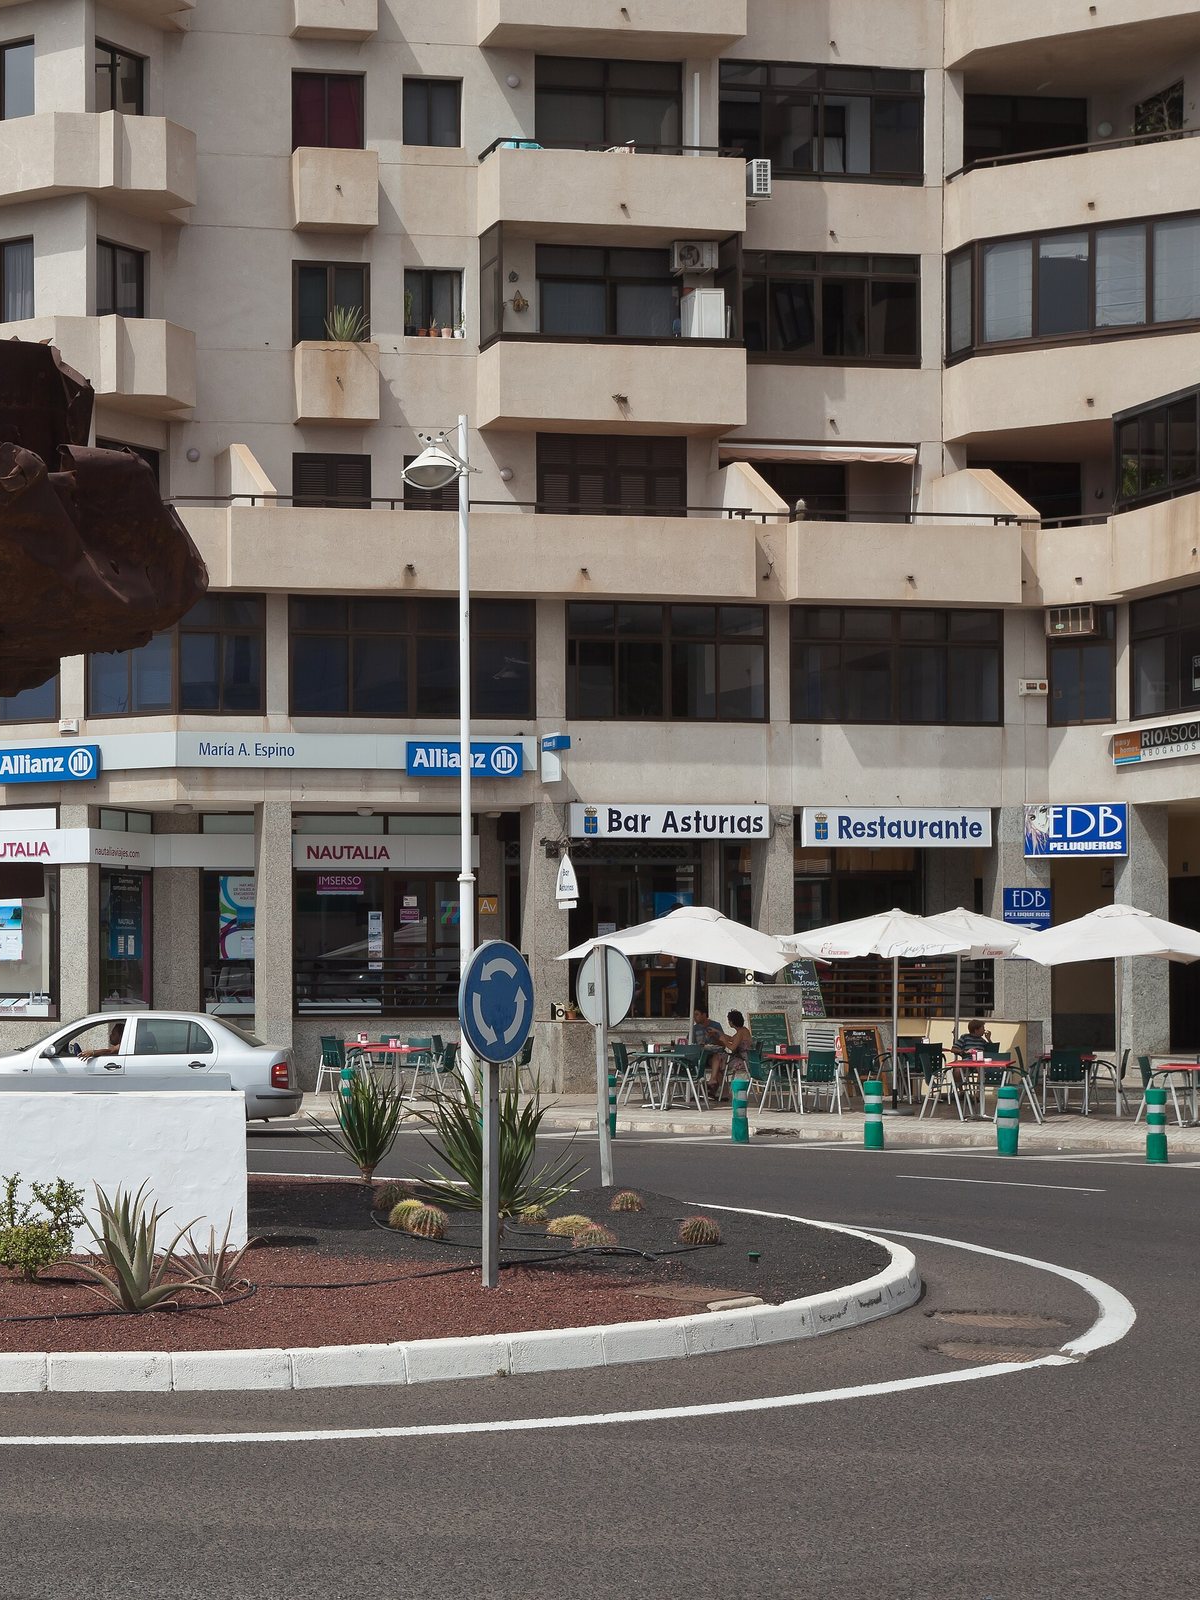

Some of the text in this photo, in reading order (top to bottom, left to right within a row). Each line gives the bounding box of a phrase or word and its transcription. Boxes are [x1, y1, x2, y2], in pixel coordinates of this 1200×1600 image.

[199, 741, 296, 760] María A. Espino
[1141, 742, 1196, 757] ABOGADOS
[0, 754, 65, 775] Allianz
[607, 807, 764, 834] Bar Asturias
[837, 814, 983, 841] Restaurante
[1048, 806, 1123, 838] EDB
[306, 846, 390, 860] NAUTALIA
[1050, 840, 1122, 851] PELUQUEROS
[318, 876, 362, 886] IMSERSO
[480, 900, 497, 912] Av
[1012, 890, 1046, 908] EDB
